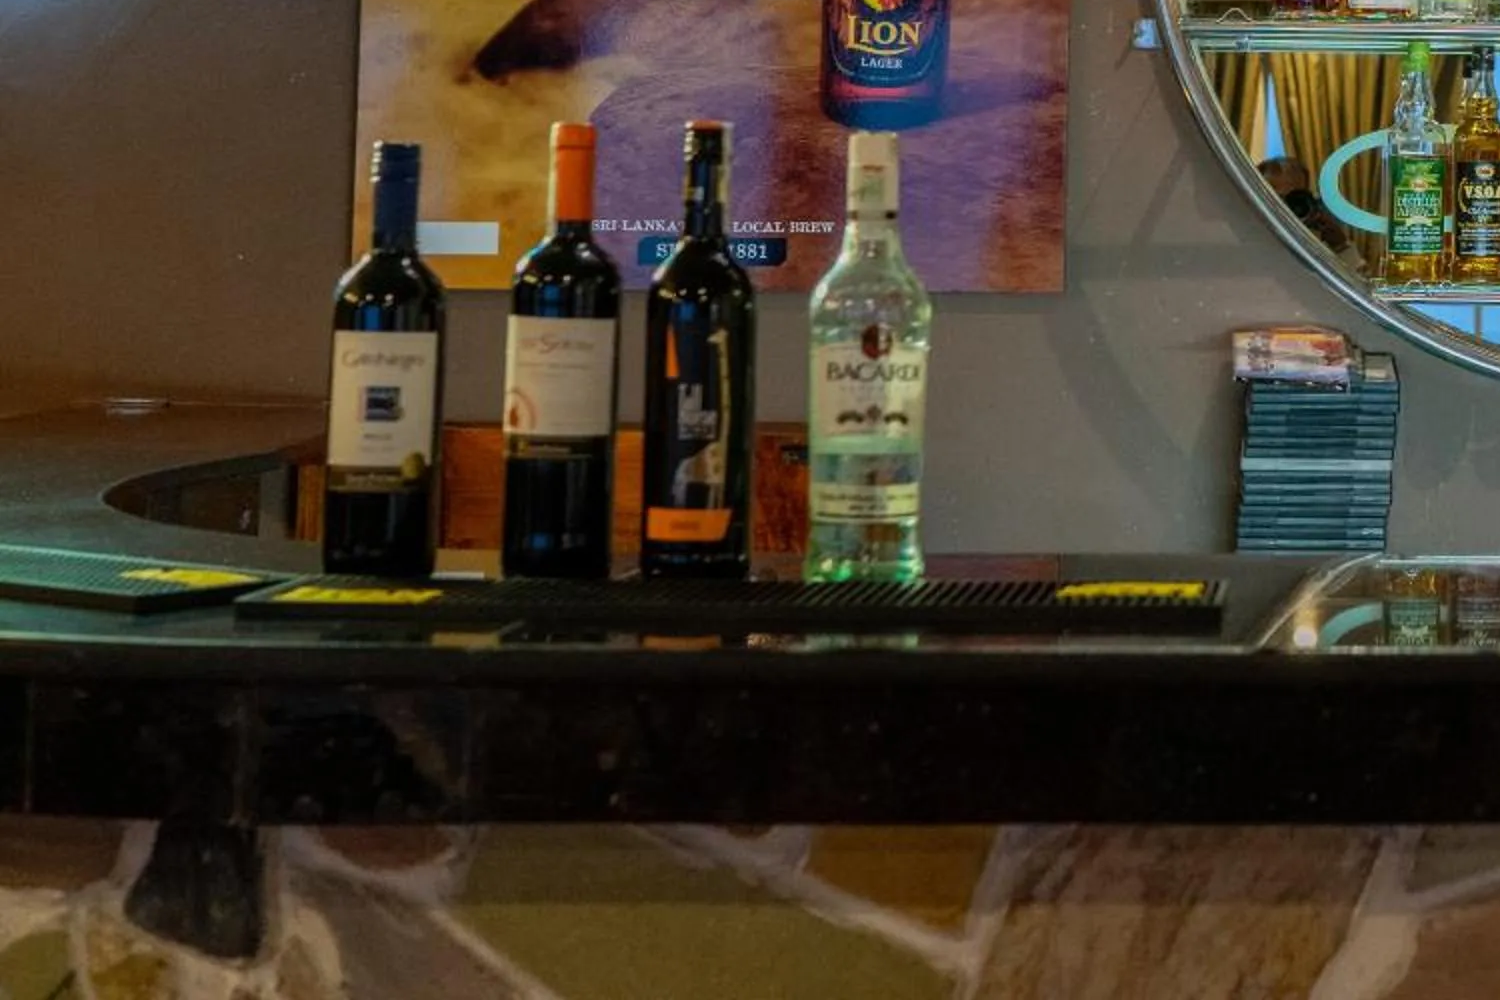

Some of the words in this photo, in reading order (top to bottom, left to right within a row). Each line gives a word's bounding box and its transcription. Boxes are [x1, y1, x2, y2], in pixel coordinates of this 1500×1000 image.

[846, 15, 923, 55] LION
[861, 56, 903, 69] LAGER
[591, 219, 618, 233] SRI
[732, 221, 785, 233] LOCAL
[789, 221, 835, 233] BREW
[826, 361, 920, 383] BACARDI
